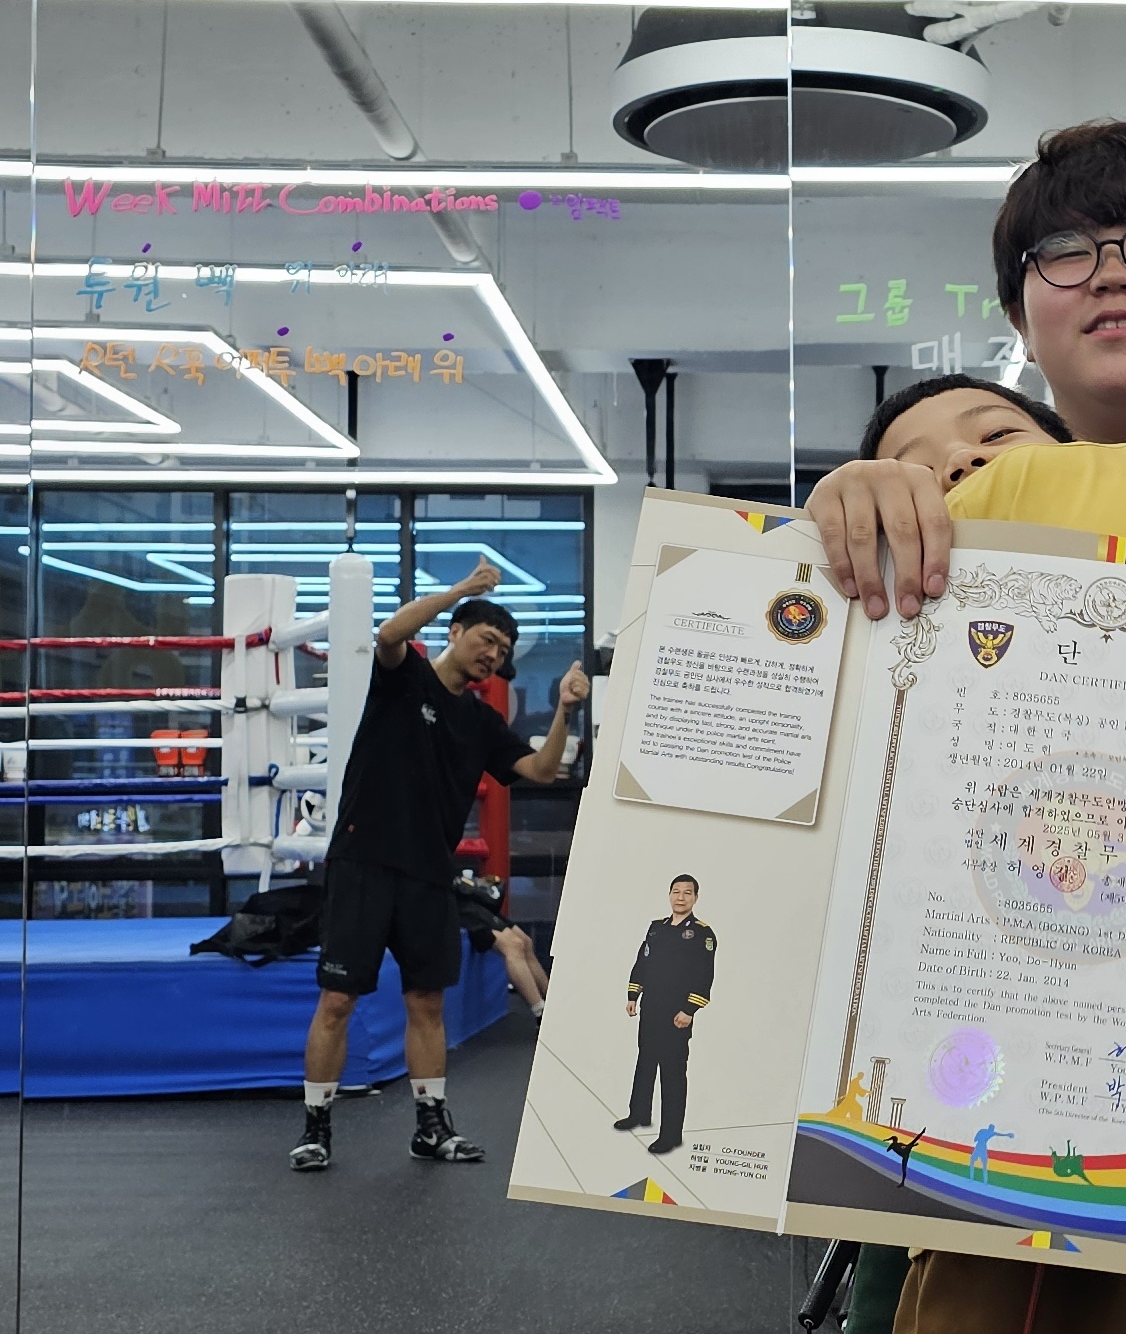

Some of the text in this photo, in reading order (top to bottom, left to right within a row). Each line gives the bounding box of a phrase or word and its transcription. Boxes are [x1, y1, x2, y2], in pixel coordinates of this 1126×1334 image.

[64, 176, 181, 217] Week
[279, 179, 499, 215] Combinations
[674, 618, 745, 635] CERTIFICATE
[1040, 671, 1068, 683] DAN
[1013, 692, 1060, 705] 8035655
[928, 891, 945, 902] No.
[925, 908, 964, 922] Martial
[967, 913, 990, 924] Arts
[923, 926, 982, 943] Nationality
[1001, 934, 1058, 950] REPUBLIC
[1083, 944, 1121, 958] KOREA
[920, 944, 987, 960] Name in Full
[918, 961, 944, 973] Date
[946, 965, 958, 974] of
[959, 966, 987, 978] Birth
[916, 980, 936, 990] This
[953, 985, 963, 994] to
[967, 988, 996, 998] certify
[1001, 990, 1018, 1001] that
[1024, 992, 1038, 1002] the
[1043, 995, 1069, 1006] above
[1074, 1001, 1103, 1011] named
[912, 1007, 987, 1023] Arts Federation.
[914, 996, 960, 1006] completed
[964, 999, 978, 1008] the
[983, 1001, 1001, 1011] Dan
[1006, 1006, 1051, 1017] promotion
[1057, 1010, 1072, 1020] test
[1078, 1013, 1088, 1023] by
[1093, 1015, 1108, 1024] the
[1041, 1079, 1088, 1094] President
[722, 1147, 766, 1158] CO-FOUNDER
